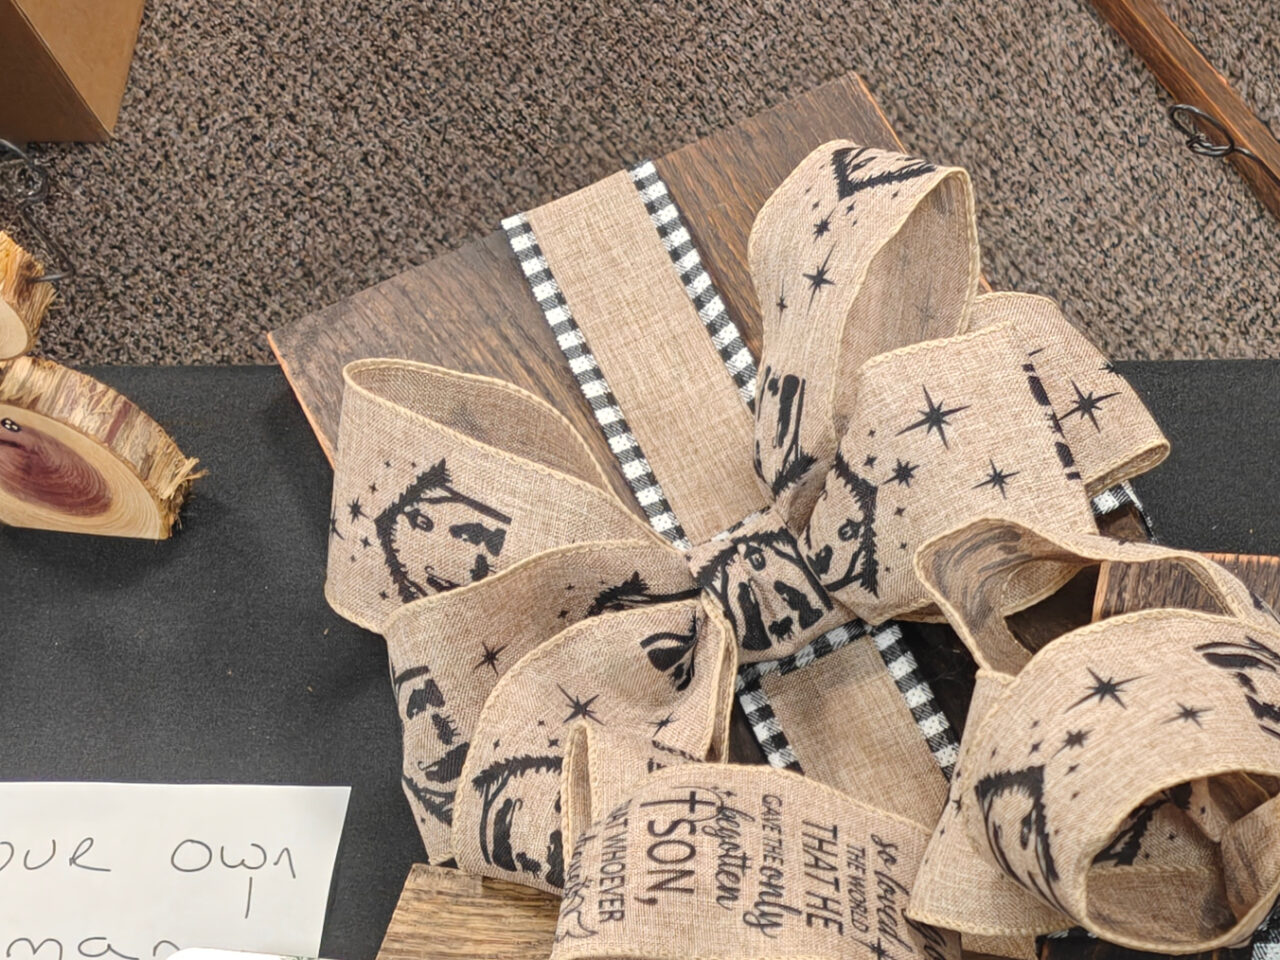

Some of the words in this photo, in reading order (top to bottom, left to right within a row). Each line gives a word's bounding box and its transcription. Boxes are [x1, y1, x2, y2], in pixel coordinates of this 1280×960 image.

[760, 793, 782, 838] GAVE
[598, 830, 628, 923] WHOEVER
[701, 800, 757, 911] begotten
[763, 836, 786, 868] THE
[802, 818, 839, 894] THAT
[847, 843, 867, 880] THE
[743, 865, 804, 939] only
[806, 894, 845, 937] HE
[848, 879, 870, 934] WORLD
